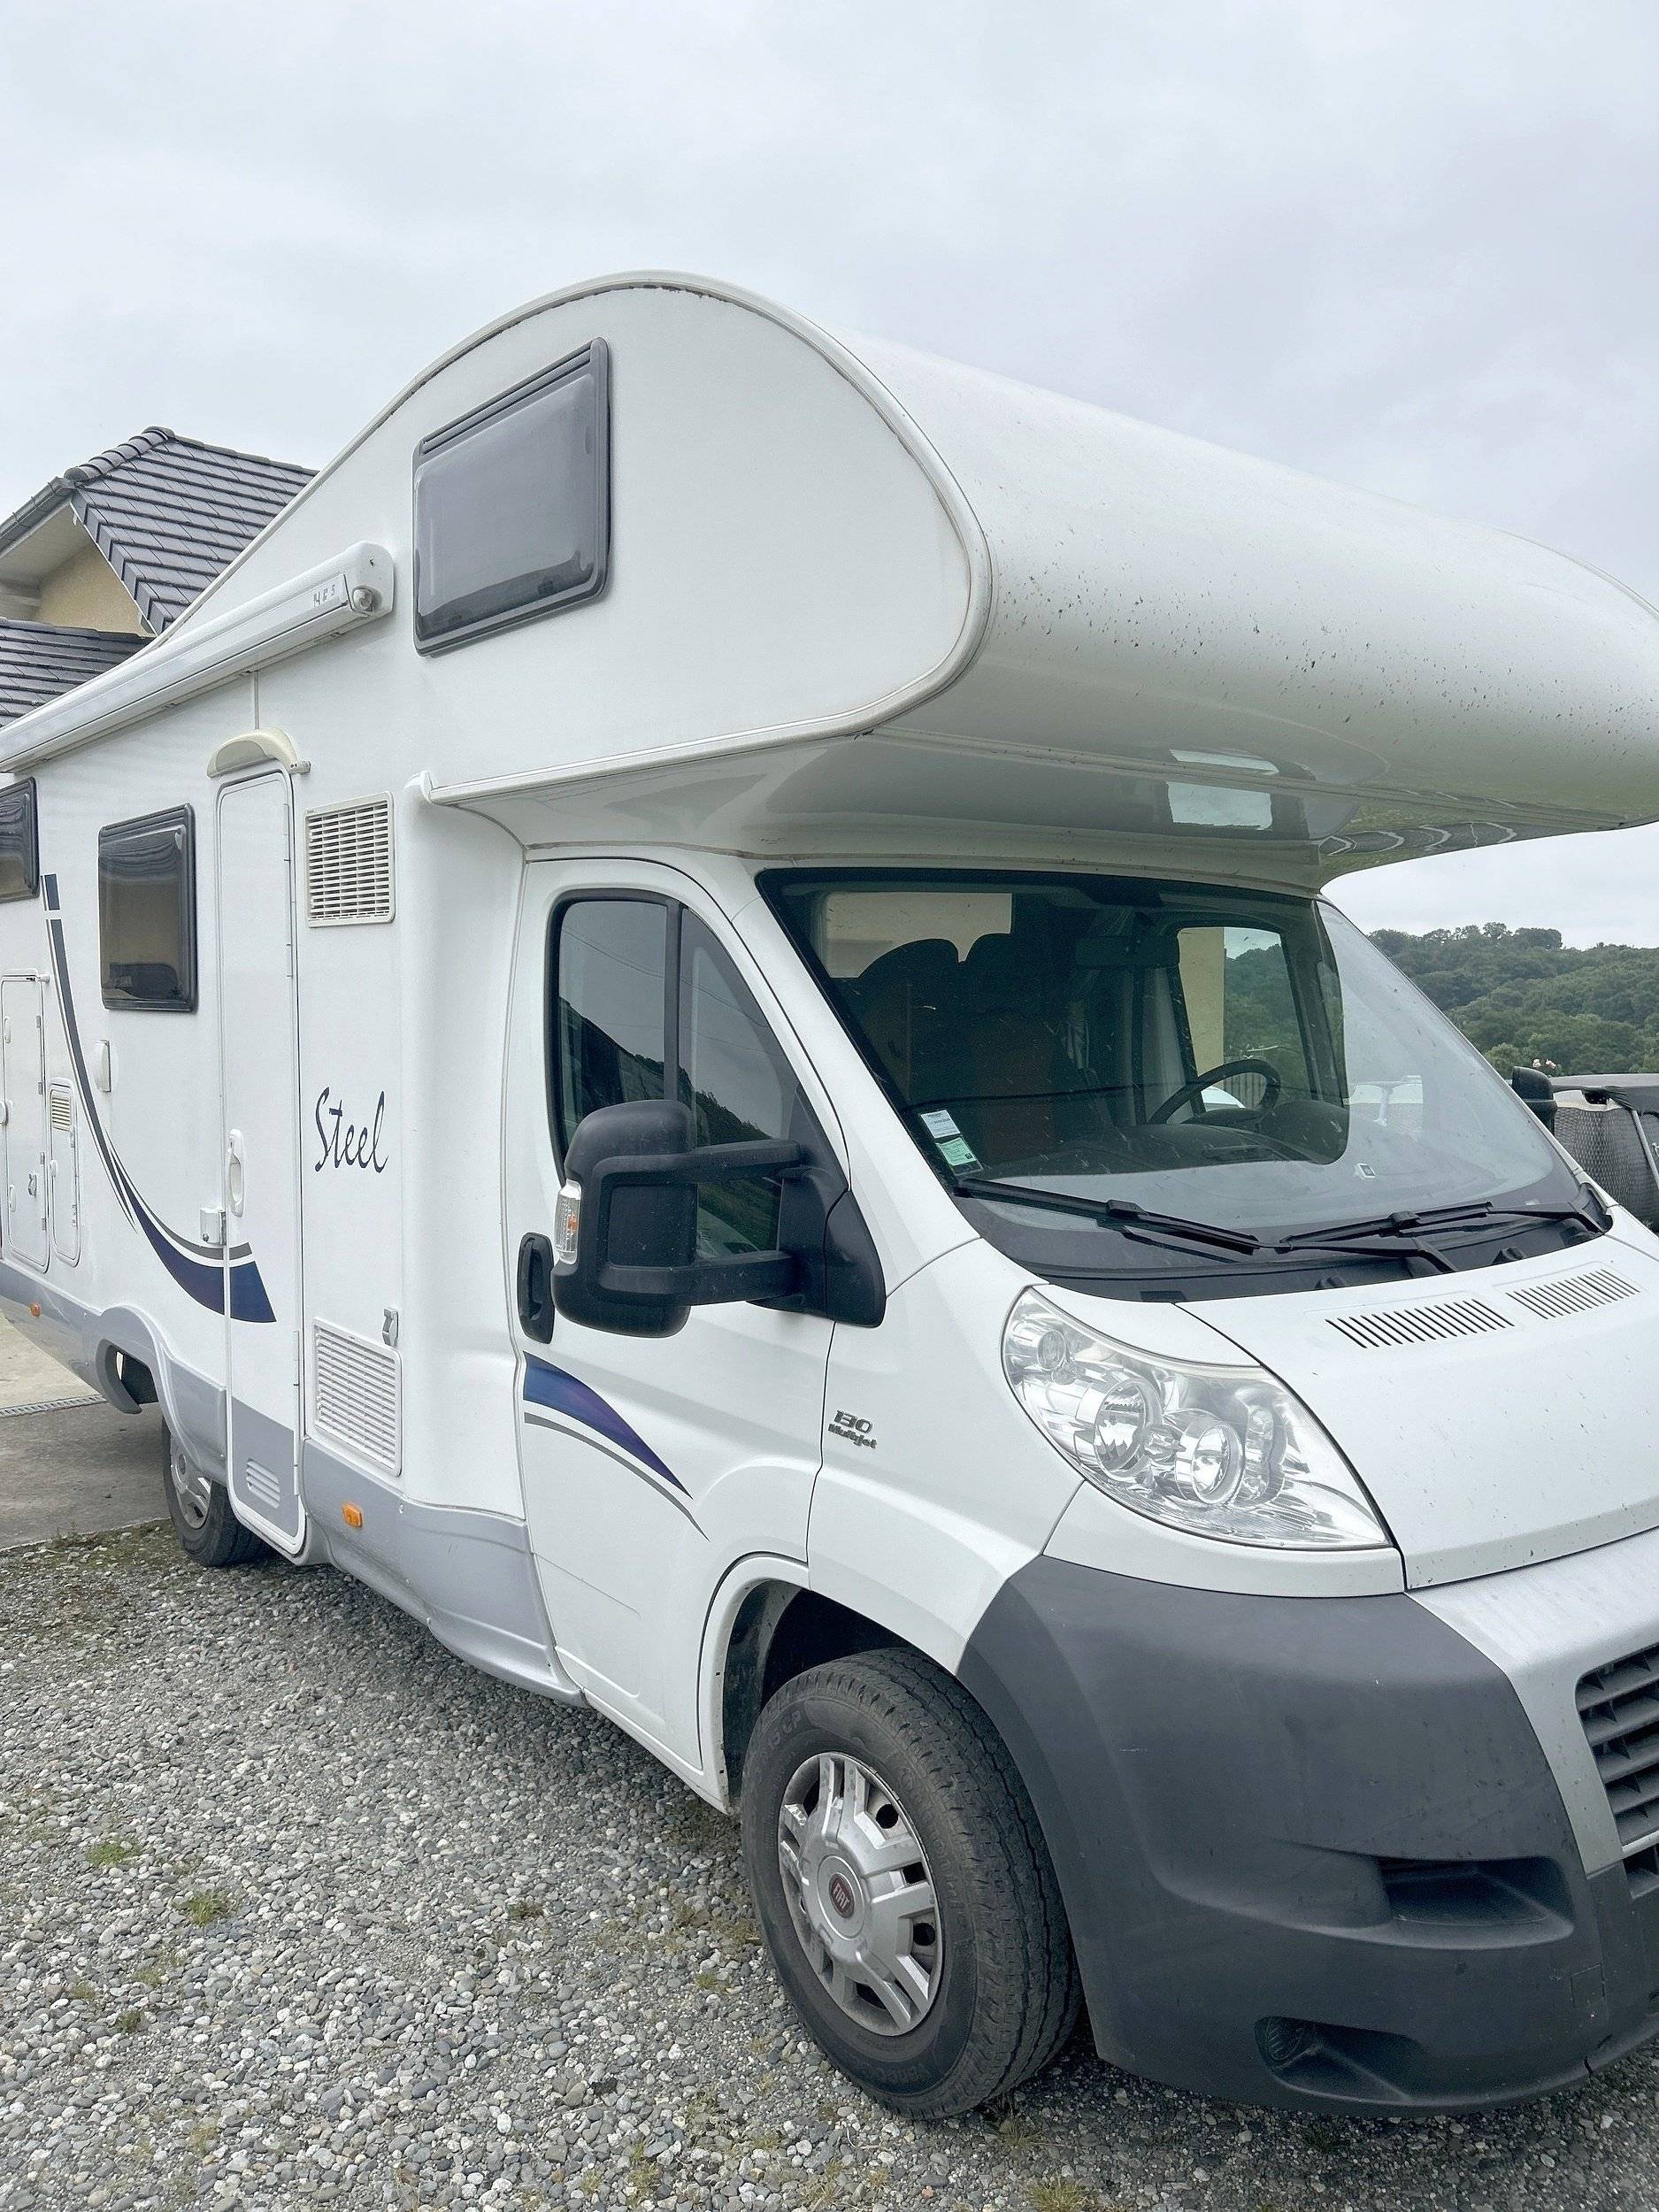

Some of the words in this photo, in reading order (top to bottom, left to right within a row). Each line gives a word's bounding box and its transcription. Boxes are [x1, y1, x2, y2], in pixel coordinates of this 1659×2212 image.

[314, 1087, 389, 1173] Steel
[834, 1409, 873, 1434] 130
[833, 1883, 849, 1909] FIAT
